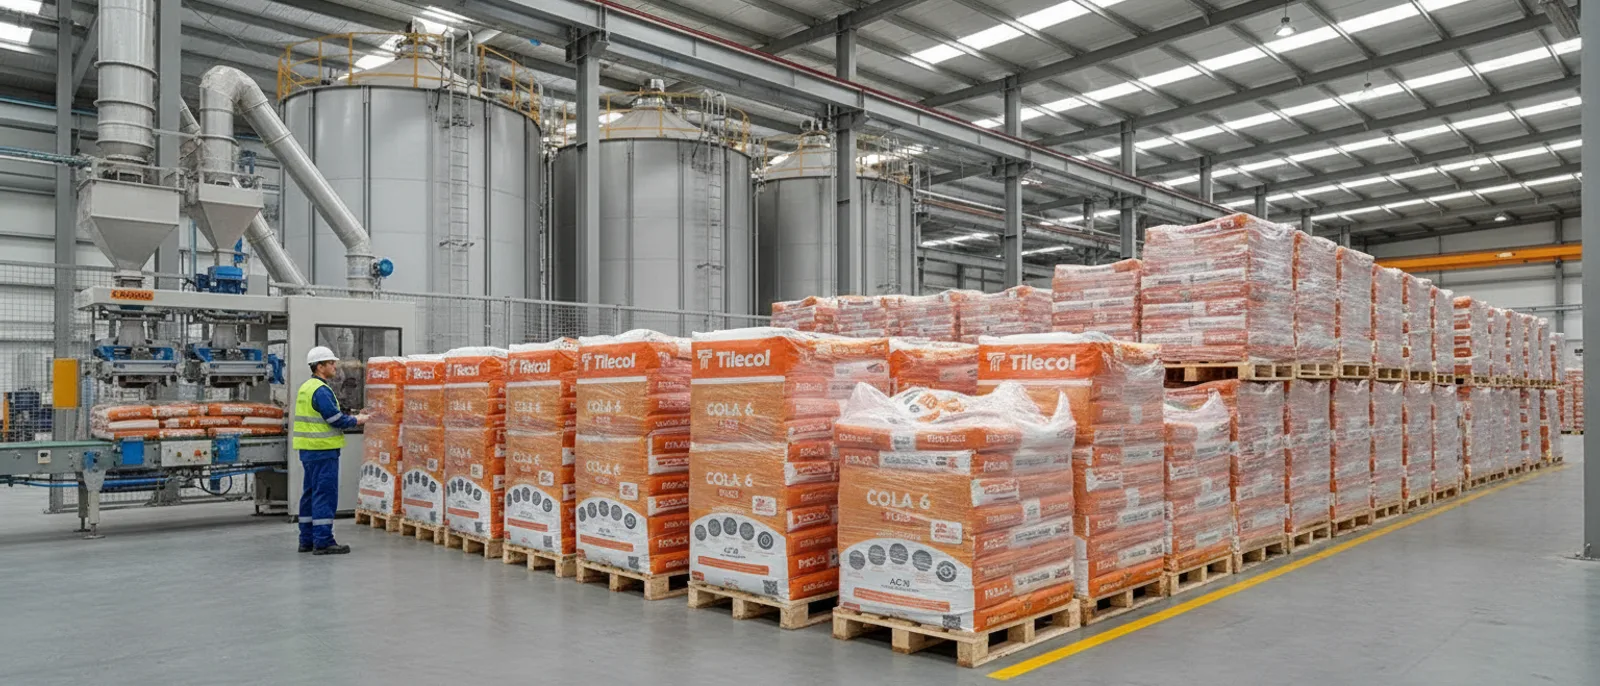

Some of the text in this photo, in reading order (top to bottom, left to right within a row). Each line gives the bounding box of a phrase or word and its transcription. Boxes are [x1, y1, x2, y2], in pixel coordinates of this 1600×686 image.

[594, 353, 636, 370] Tilecol
[716, 349, 771, 368] Tilecol
[1009, 353, 1076, 371] Tilecol
[706, 402, 742, 417] COLA
[706, 471, 753, 488] COLA 6
[866, 488, 931, 510] COLA 6
